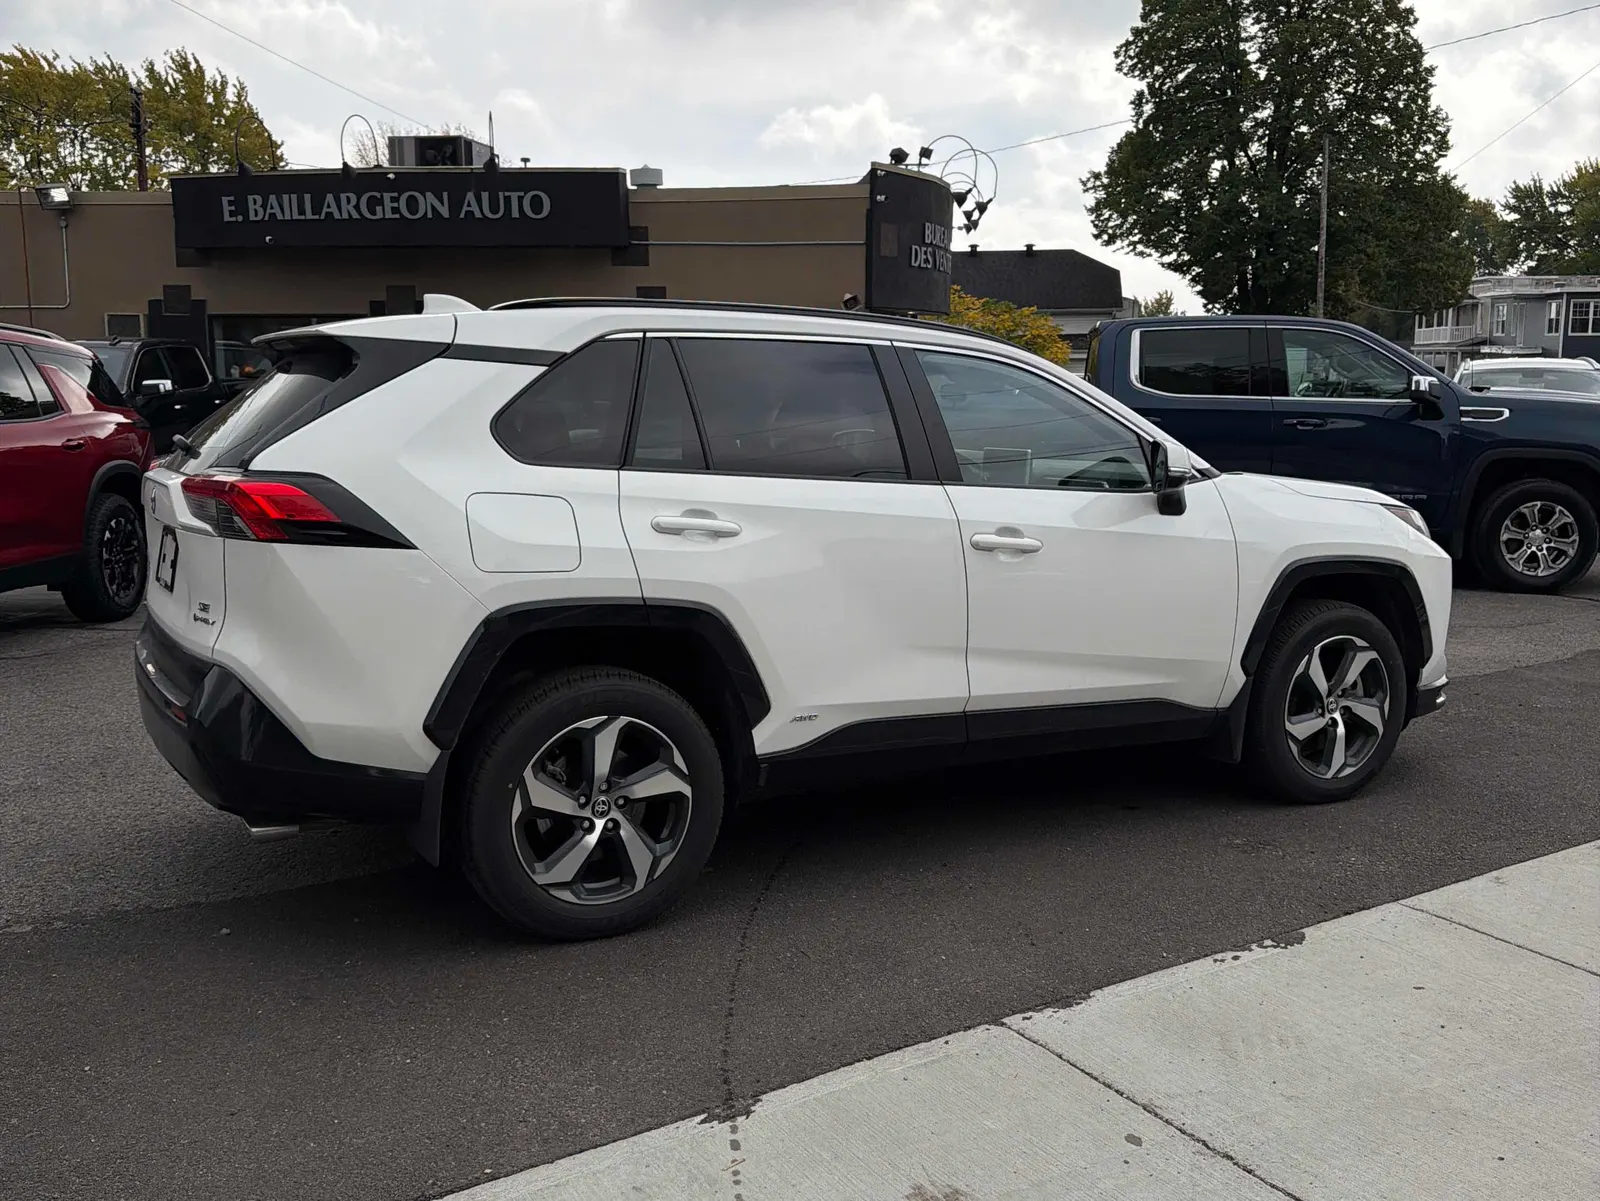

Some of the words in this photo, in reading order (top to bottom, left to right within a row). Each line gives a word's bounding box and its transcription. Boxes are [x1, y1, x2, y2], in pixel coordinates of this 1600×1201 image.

[221, 196, 243, 222] E.
[247, 191, 450, 221] BAILLARGEON
[459, 190, 551, 219] AUTO
[911, 245, 933, 268] DES
